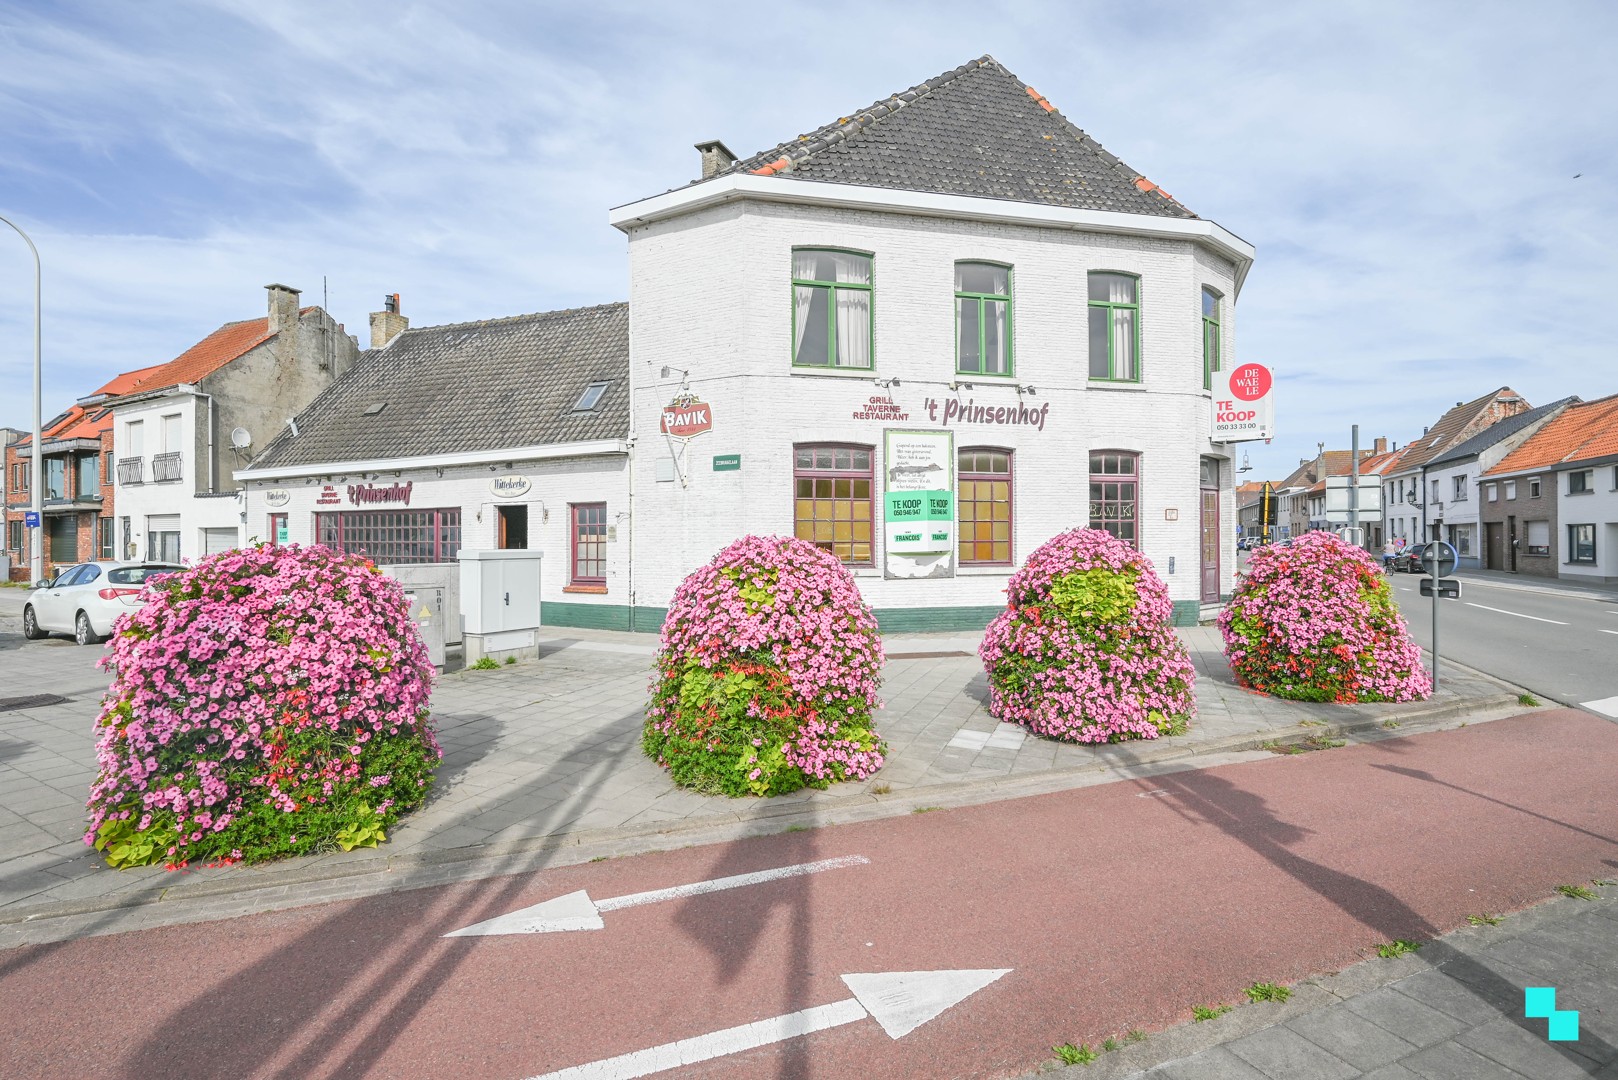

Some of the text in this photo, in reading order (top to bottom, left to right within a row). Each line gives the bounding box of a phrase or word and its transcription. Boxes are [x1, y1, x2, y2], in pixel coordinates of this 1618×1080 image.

[1244, 368, 1259, 378] DE
[1236, 378, 1259, 386] WAE
[1246, 386, 1259, 396] LE
[863, 404, 900, 412] TAVERNE
[1216, 401, 1232, 410] TE
[664, 410, 708, 426] BAVIK
[853, 412, 909, 421] RESTAURANT
[942, 398, 1049, 431] Prinsenhof
[1216, 410, 1256, 422] KOOP
[892, 500, 921, 509] TE KOOP
[930, 499, 948, 508] TE KOOP
